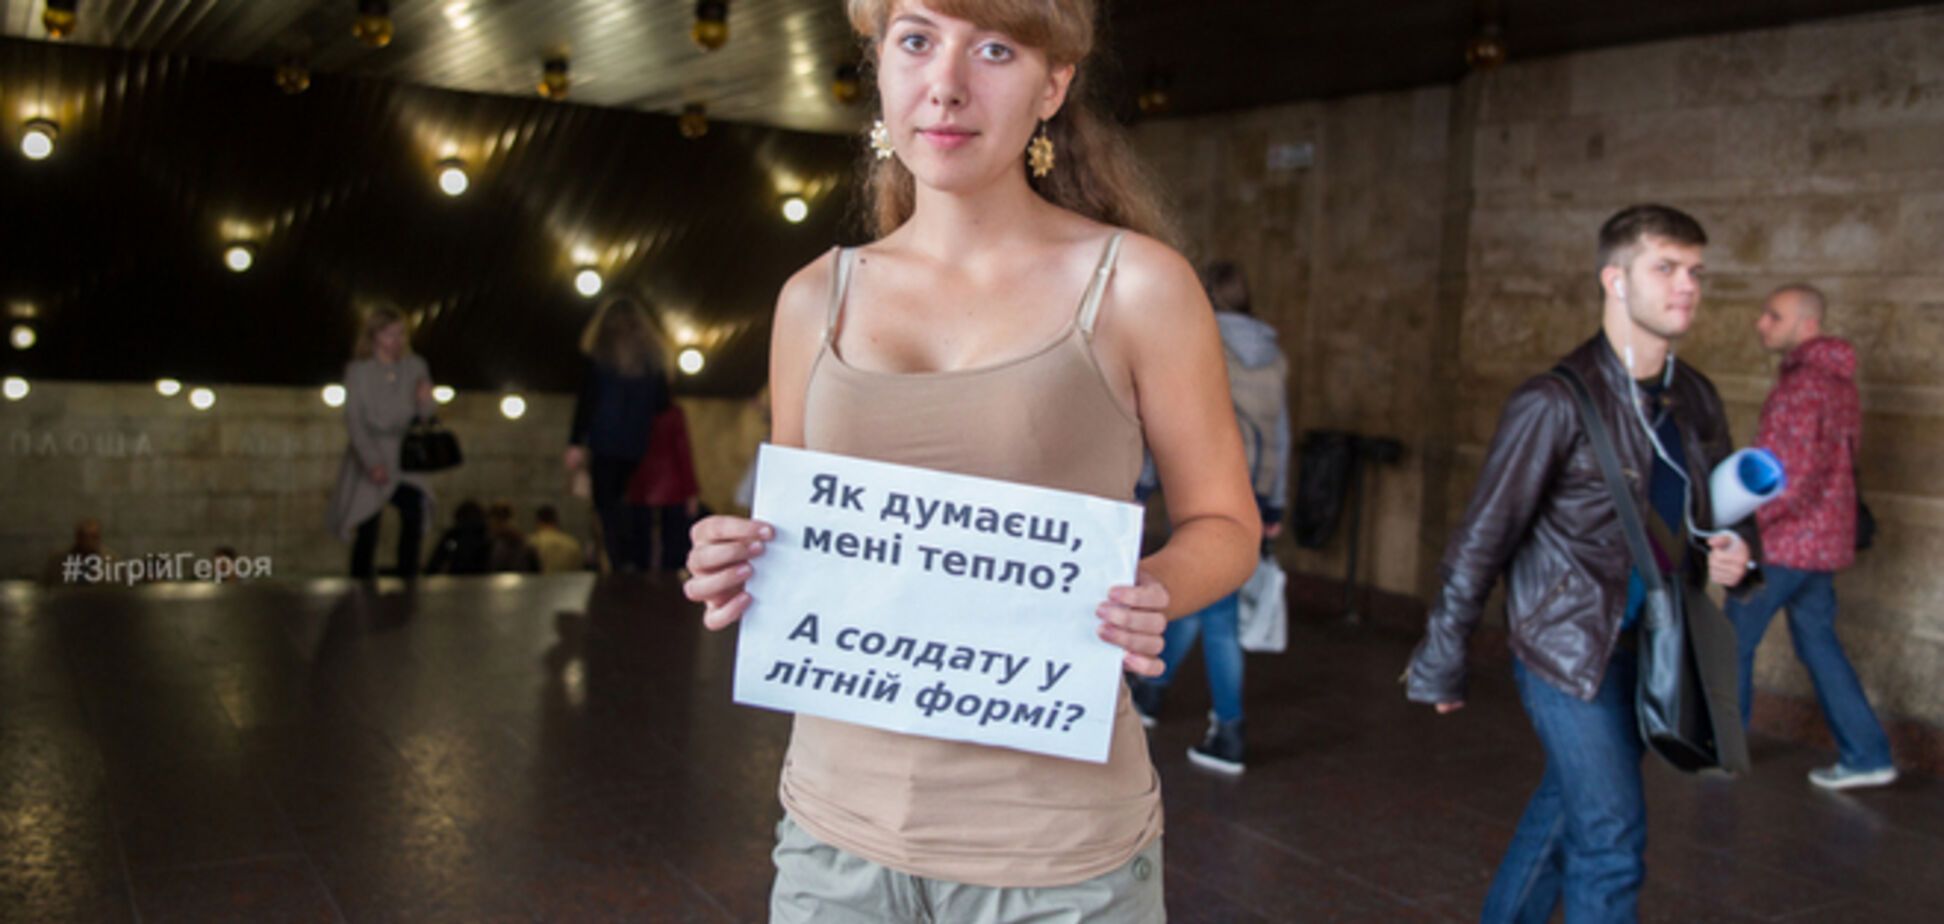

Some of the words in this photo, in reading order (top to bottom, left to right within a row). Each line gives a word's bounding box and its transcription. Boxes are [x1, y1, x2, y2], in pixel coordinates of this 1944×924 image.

[809, 473, 865, 511] Як
[880, 492, 1085, 551] думаєш,
[802, 527, 902, 565] мені
[917, 545, 1081, 593] тепло?
[788, 613, 820, 645] А
[835, 626, 1030, 685] солдату
[1038, 660, 1071, 692] у
[765, 659, 902, 703] літній
[915, 682, 1086, 732] формі?
